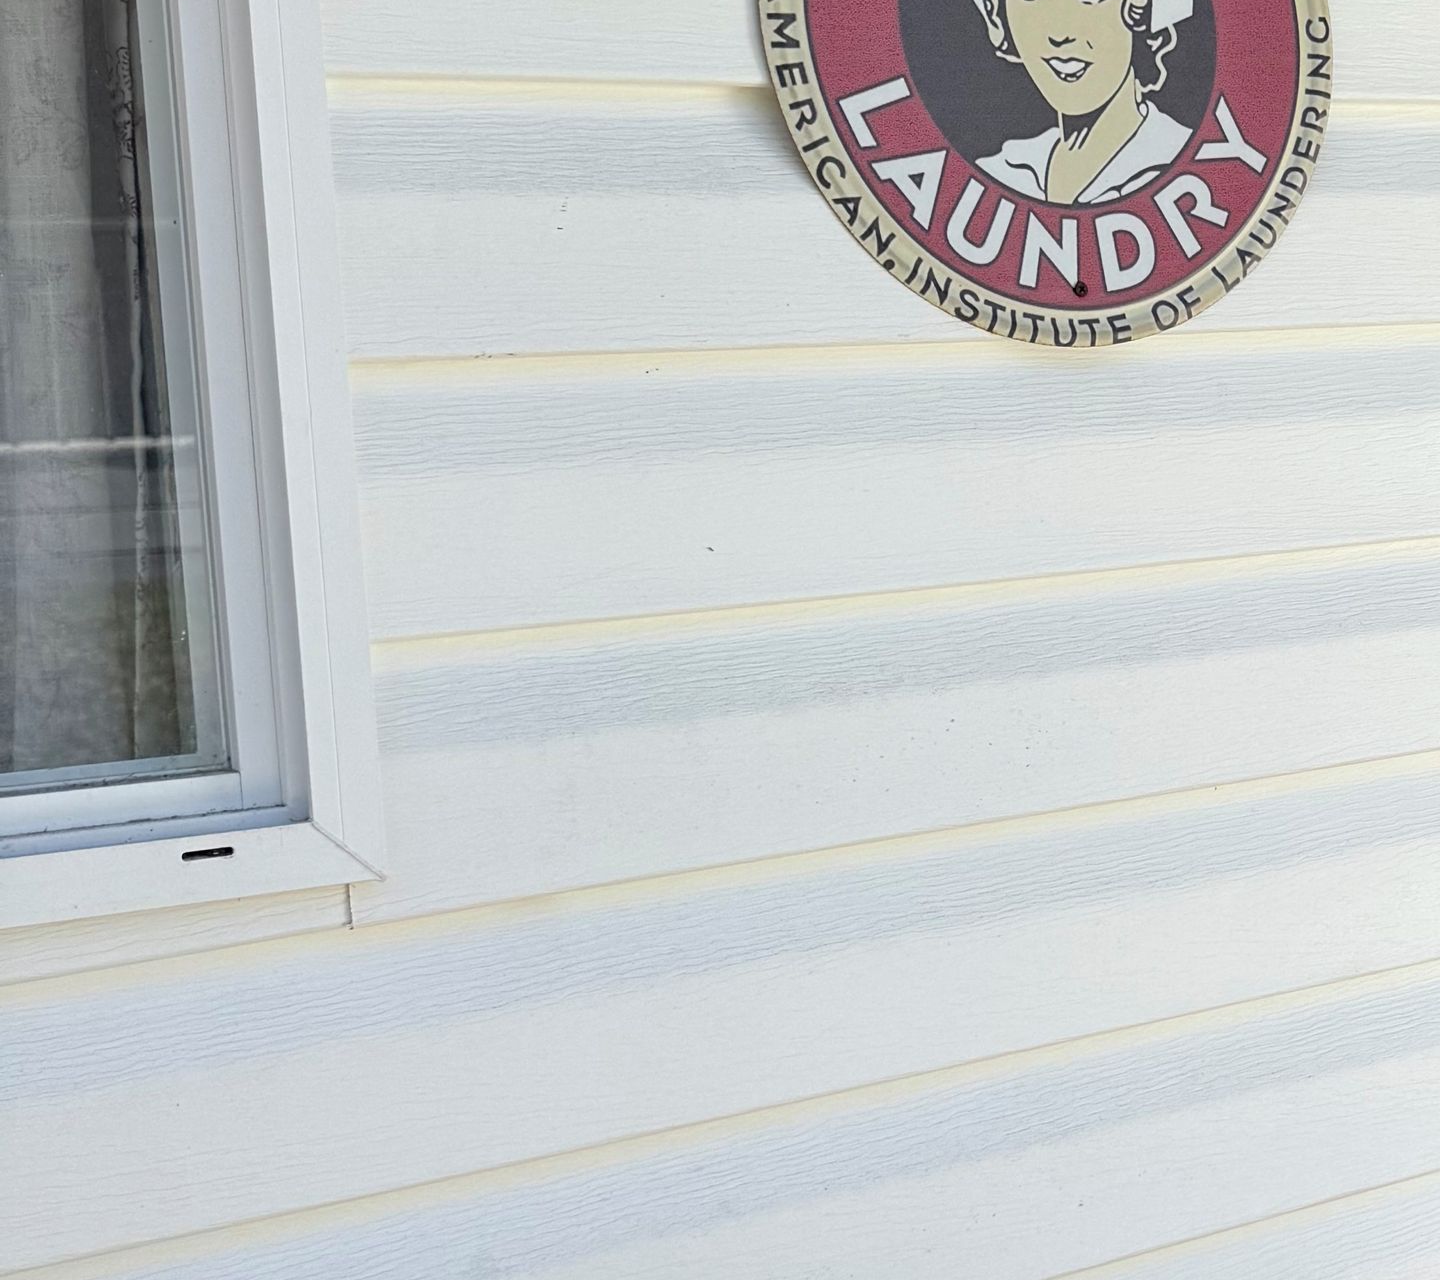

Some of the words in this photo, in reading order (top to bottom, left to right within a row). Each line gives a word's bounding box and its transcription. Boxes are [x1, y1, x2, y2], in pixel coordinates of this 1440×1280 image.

[838, 94, 1269, 294] LAUNDRY
[904, 256, 1133, 347] INSTITUTE
[1150, 285, 1202, 332] OF
[1210, 16, 1332, 293] LAUNDERING
